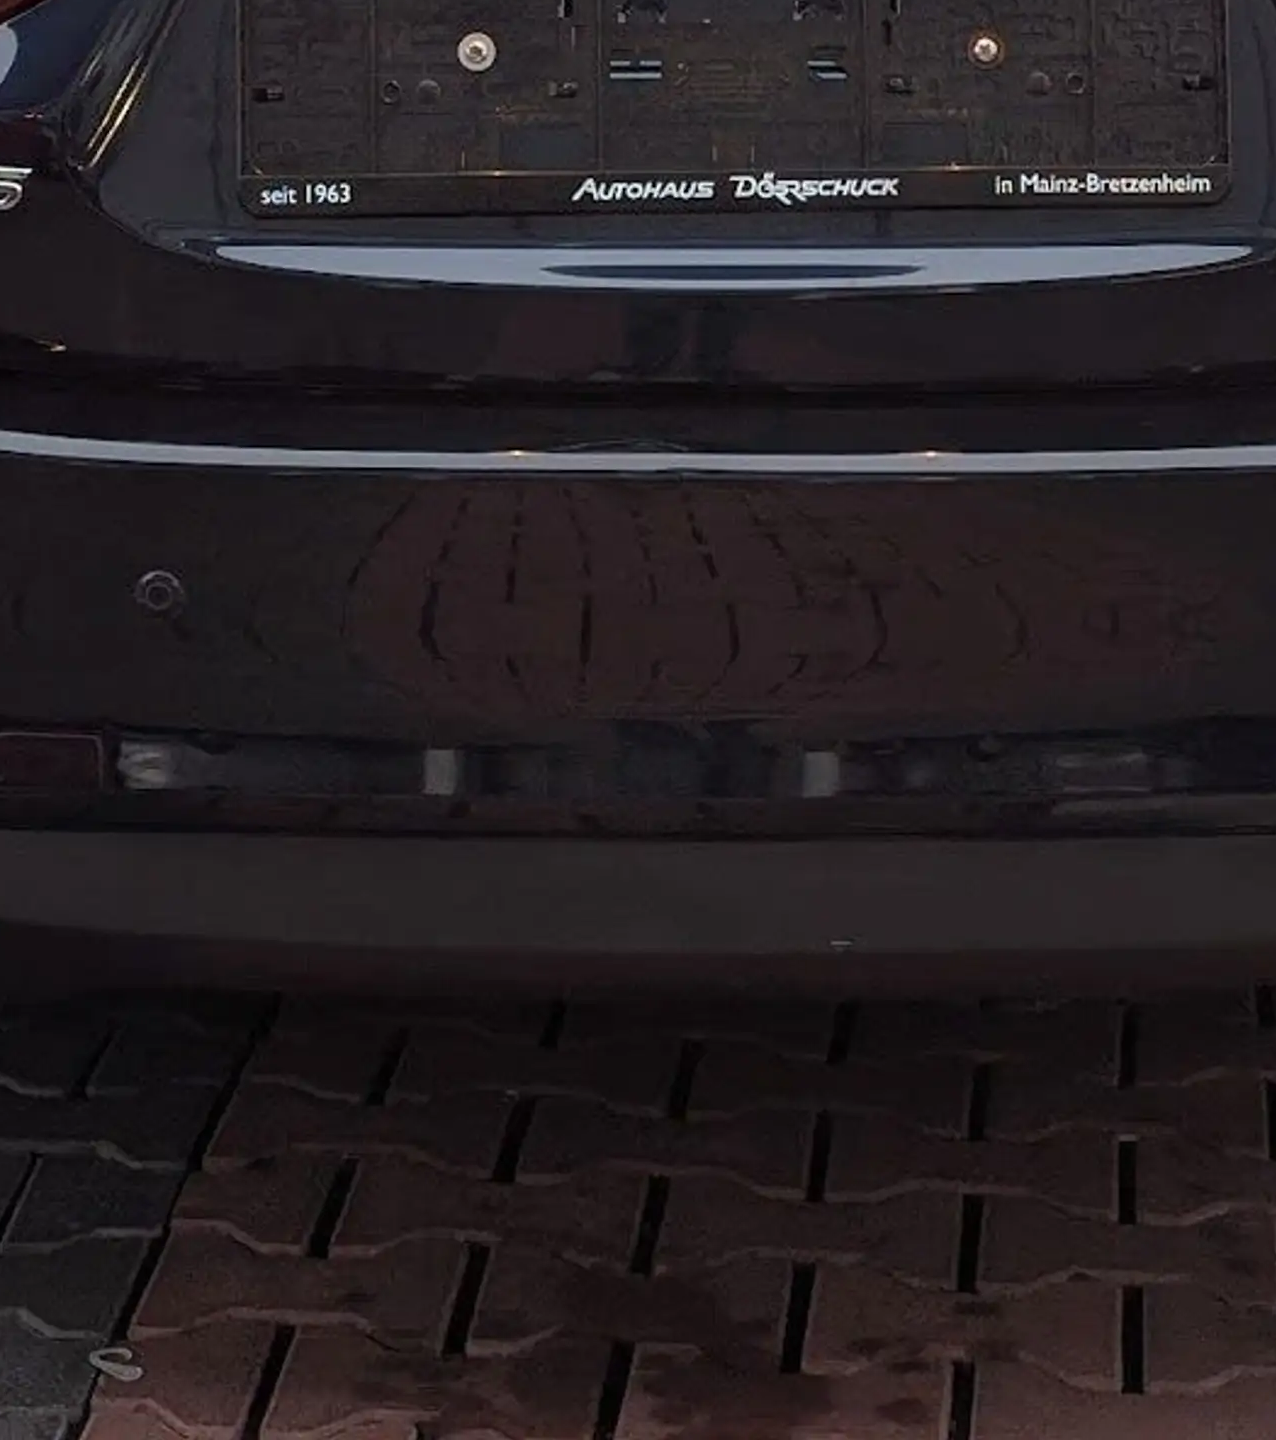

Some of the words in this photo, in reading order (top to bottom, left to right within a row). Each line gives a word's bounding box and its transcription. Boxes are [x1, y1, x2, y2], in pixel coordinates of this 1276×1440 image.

[260, 186, 297, 204] seit
[305, 184, 351, 204] 1963
[572, 177, 715, 201] AUTOHAUS
[995, 175, 1013, 194] in
[1020, 173, 1211, 194] Mainz-Bretzenheim
